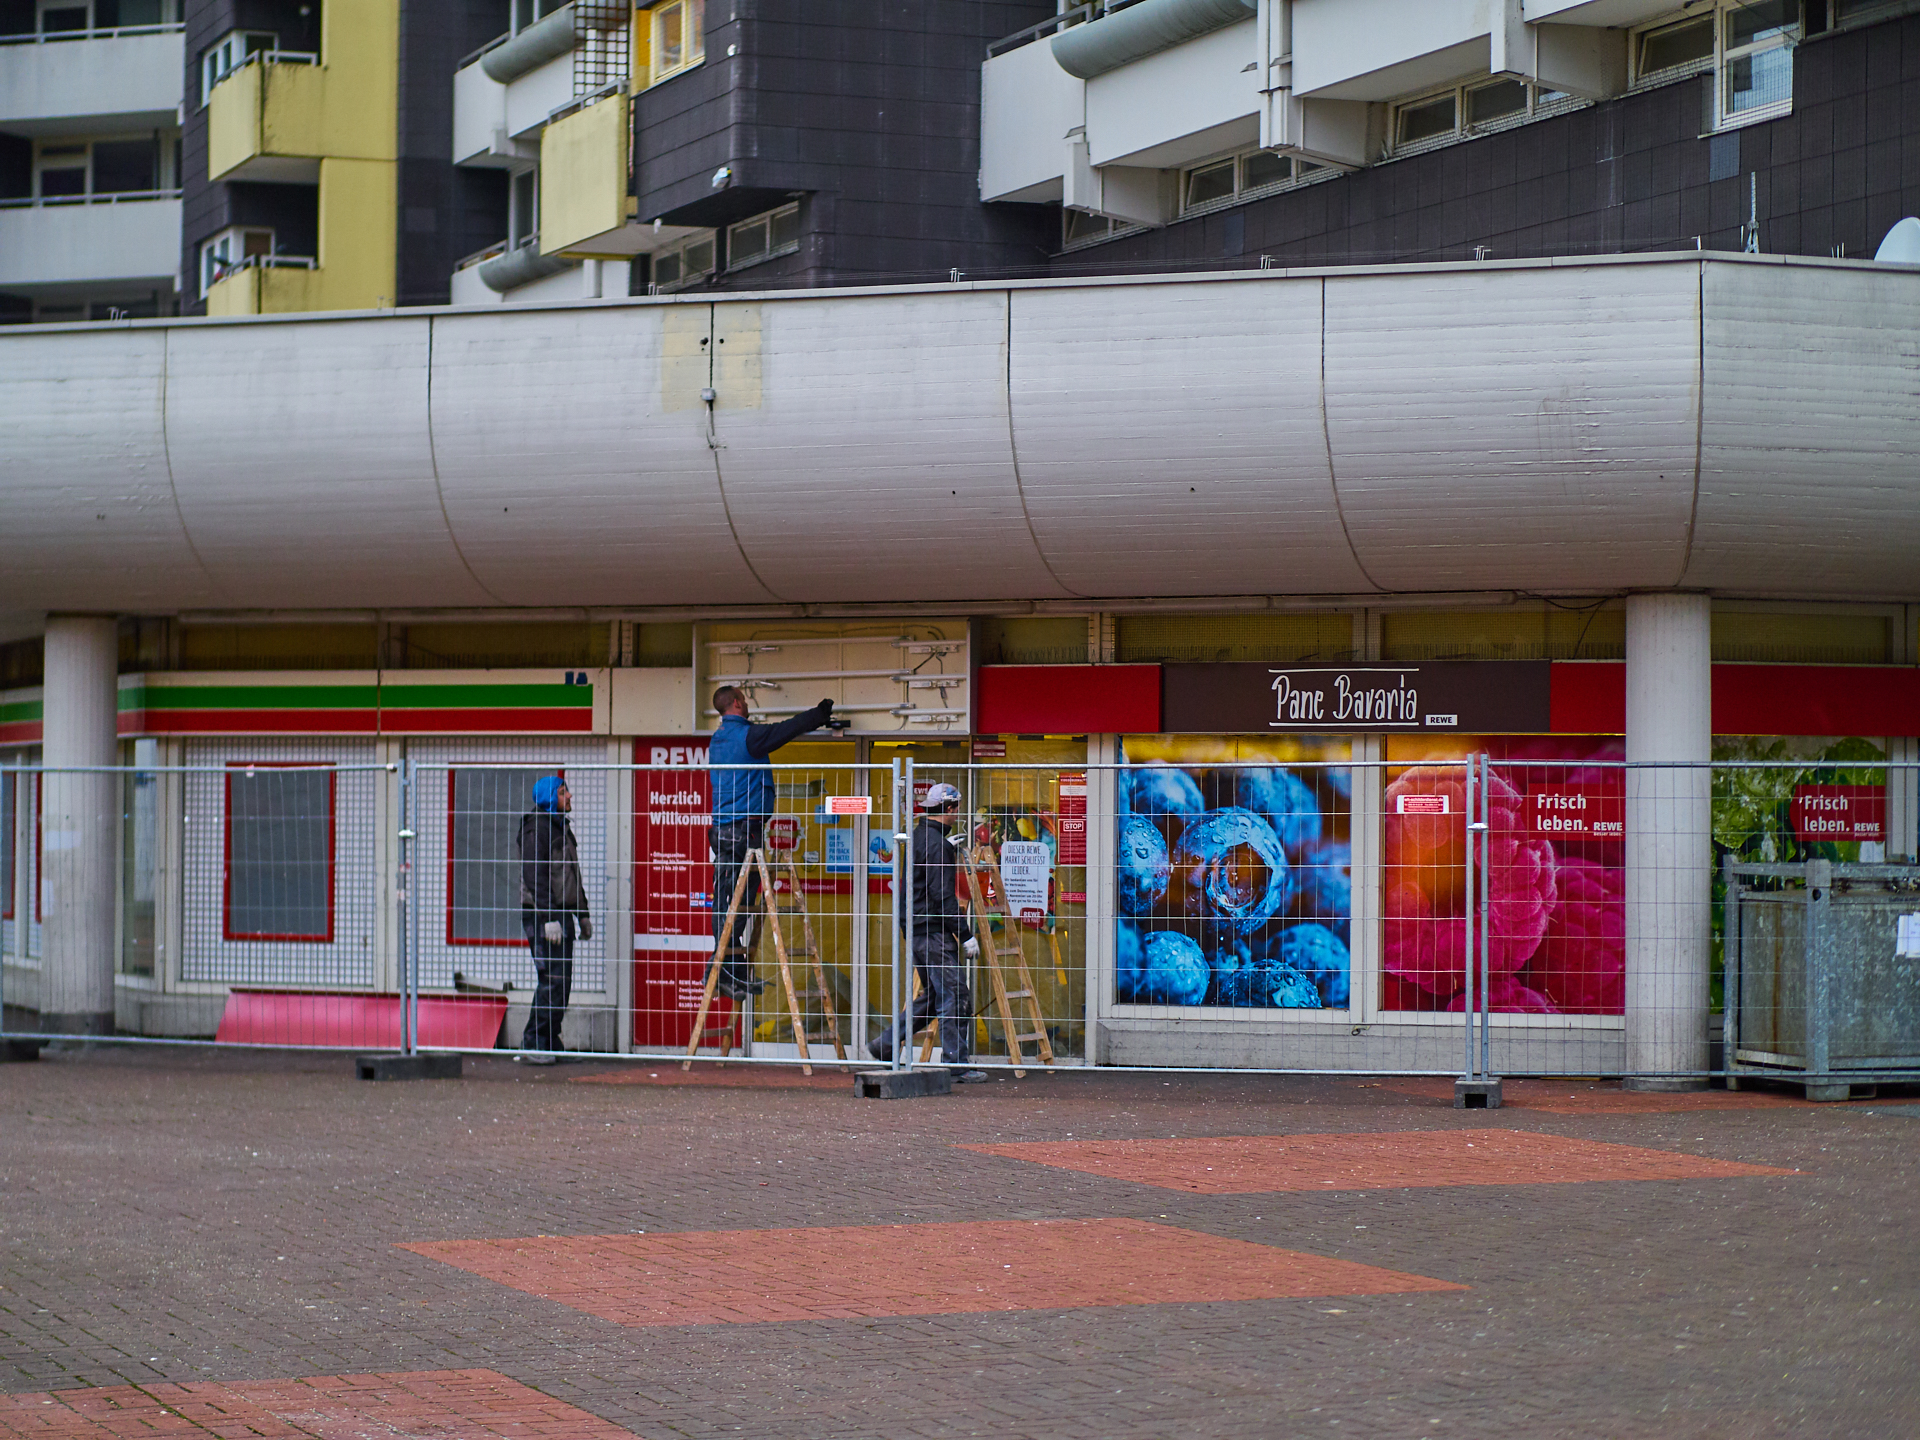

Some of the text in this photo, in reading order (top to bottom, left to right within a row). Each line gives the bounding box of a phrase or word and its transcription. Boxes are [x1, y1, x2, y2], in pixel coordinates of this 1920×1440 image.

[1271, 674, 1418, 720] Pane Bavaria
[1430, 716, 1453, 724] REWE
[651, 747, 710, 771] REW
[650, 791, 702, 805] Herzlich
[1537, 793, 1587, 810] Frisch
[1804, 794, 1849, 811] Frisch
[650, 811, 713, 826] Willkomm
[1537, 814, 1589, 831] leben.
[1804, 815, 1850, 832] leben.
[1593, 821, 1623, 831] REWE
[1854, 822, 1880, 832] REWE
[1008, 845, 1041, 855] DIESER REWE
[1004, 855, 1046, 865] MARKT SCHLIESST
[1011, 866, 1031, 875] LEIDER.
[799, 882, 836, 890] illkommen!
